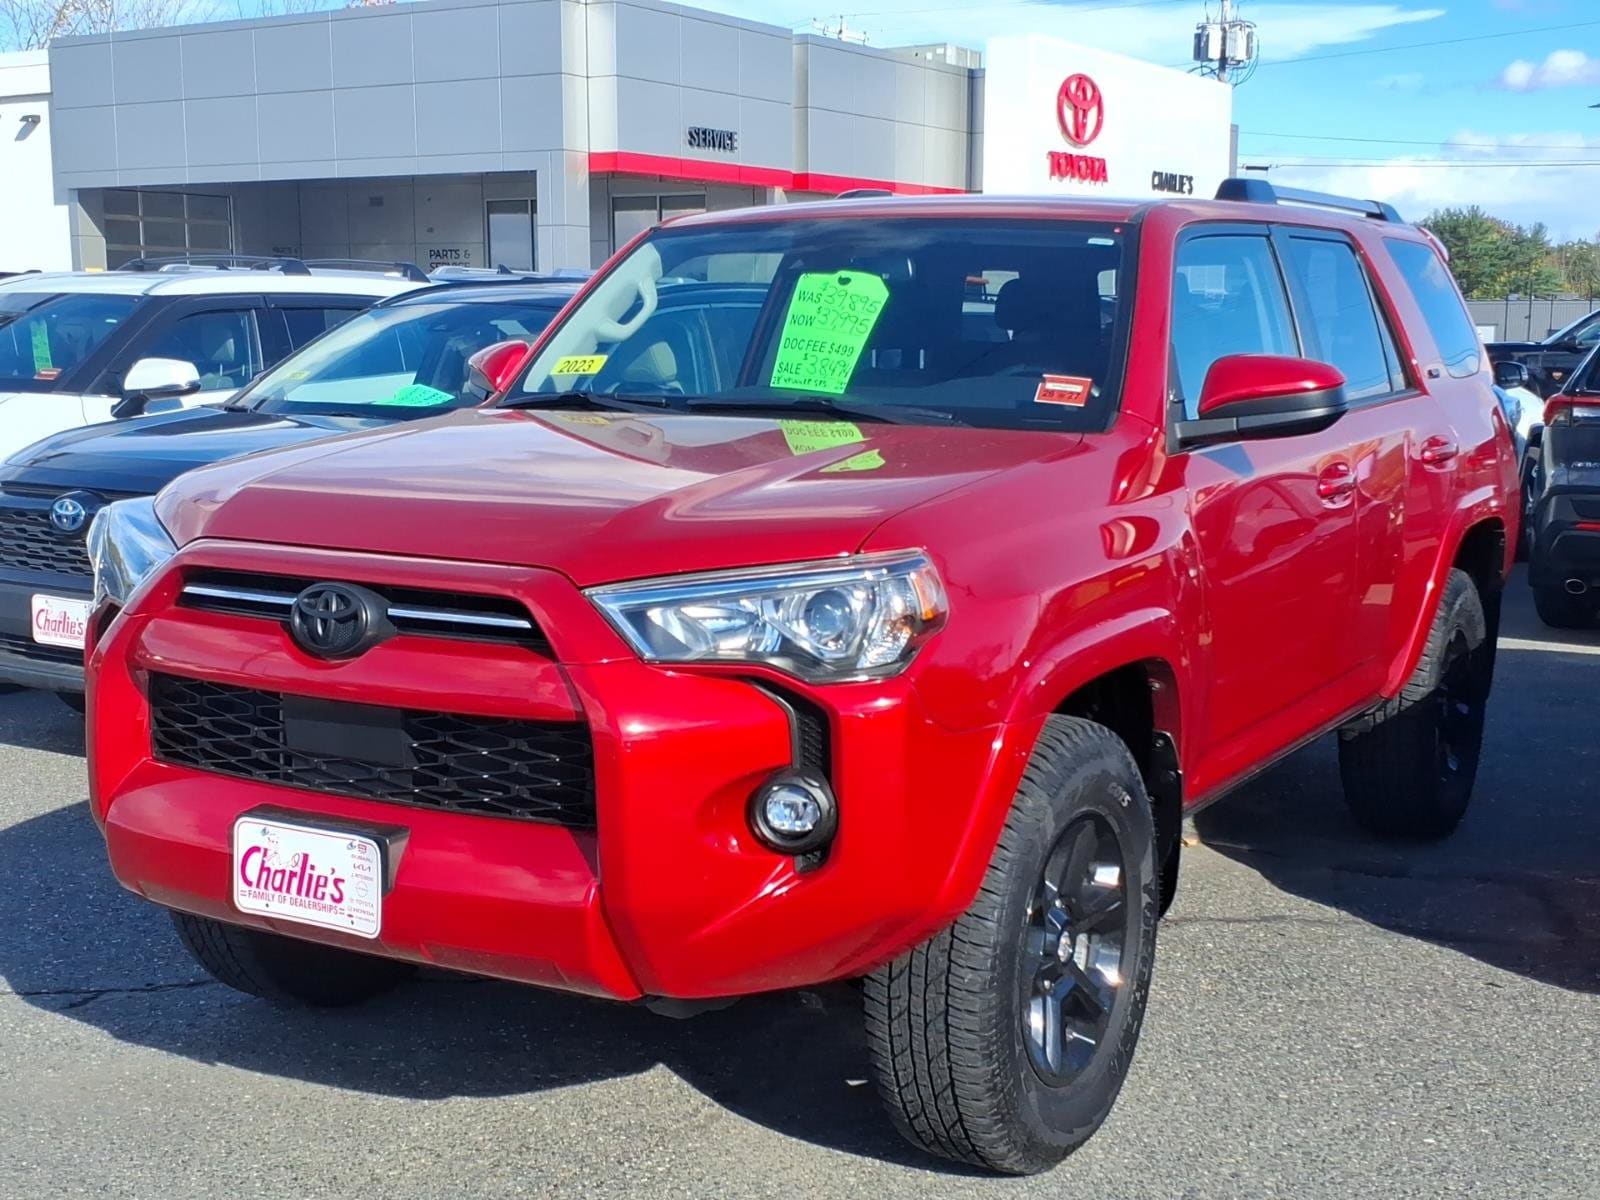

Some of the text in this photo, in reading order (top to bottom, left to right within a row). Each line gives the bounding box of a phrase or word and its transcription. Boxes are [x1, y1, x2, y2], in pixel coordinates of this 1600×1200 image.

[688, 127, 738, 152] SERVICE
[1048, 151, 1108, 184] TOYOTA
[1151, 171, 1194, 195] CHARLIE'S
[429, 249, 471, 260] PARTS &
[798, 290, 822, 304] WAS
[789, 314, 816, 327] NOW
[783, 337, 855, 358] DOC FEE $499
[557, 359, 595, 373] 2023
[777, 361, 802, 375] SALE
[36, 608, 84, 636] Charlie's
[240, 845, 345, 904] Charlie's
[248, 890, 338, 915] FAMILY OF DEALERSHIPS
